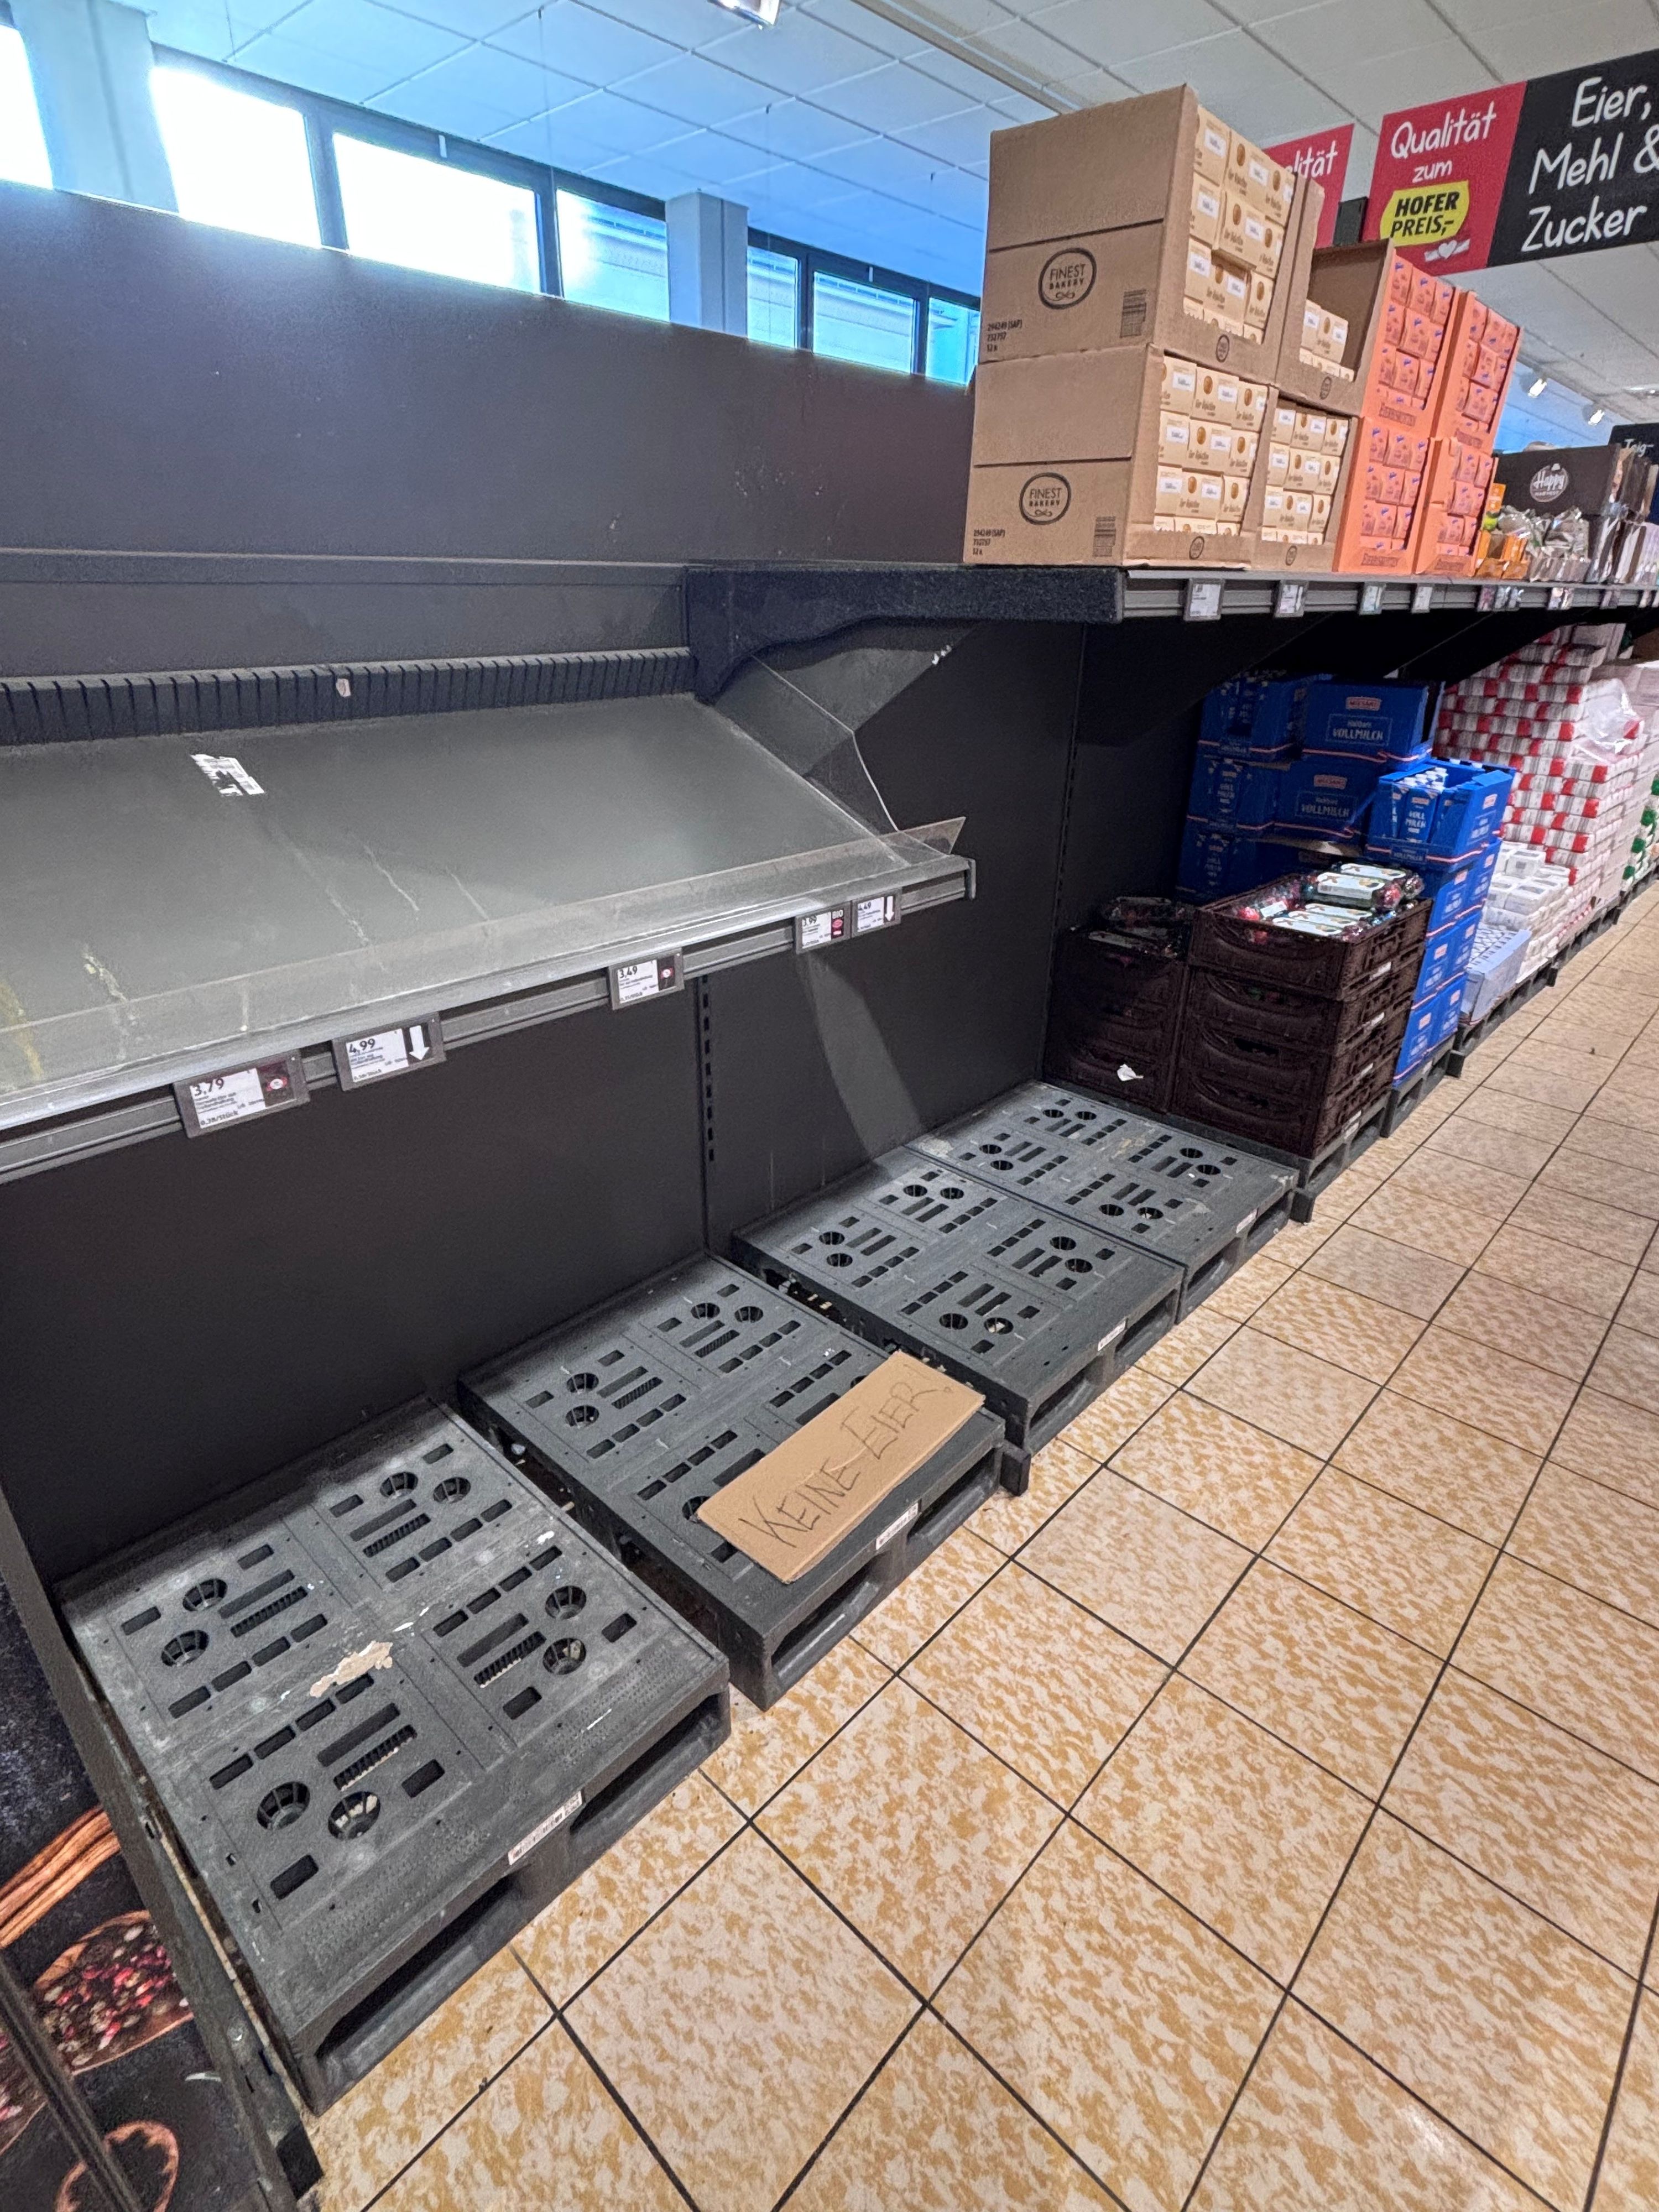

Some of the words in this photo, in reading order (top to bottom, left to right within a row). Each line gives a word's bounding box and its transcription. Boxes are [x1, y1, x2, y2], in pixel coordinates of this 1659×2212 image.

[1572, 77, 1651, 127] Eier,
[1391, 101, 1496, 159] Qualität
[1528, 132, 1624, 194] Mehl
[1634, 124, 1659, 173] &
[1412, 160, 1452, 183] zum
[1395, 191, 1460, 217] HOFER
[1521, 195, 1647, 252] Zucker
[1051, 264, 1086, 280] FINEST
[1049, 278, 1083, 290] BAKERY
[1533, 470, 1566, 492] Happy
[1030, 488, 1062, 498] FINEST
[1333, 728, 1383, 740] VOLLMILCH
[1301, 804, 1350, 817] VOLLMILCH
[349, 1039, 375, 1053] 4,99
[738, 1457, 861, 1548] KEINE
[841, 1381, 938, 1459] EIER
